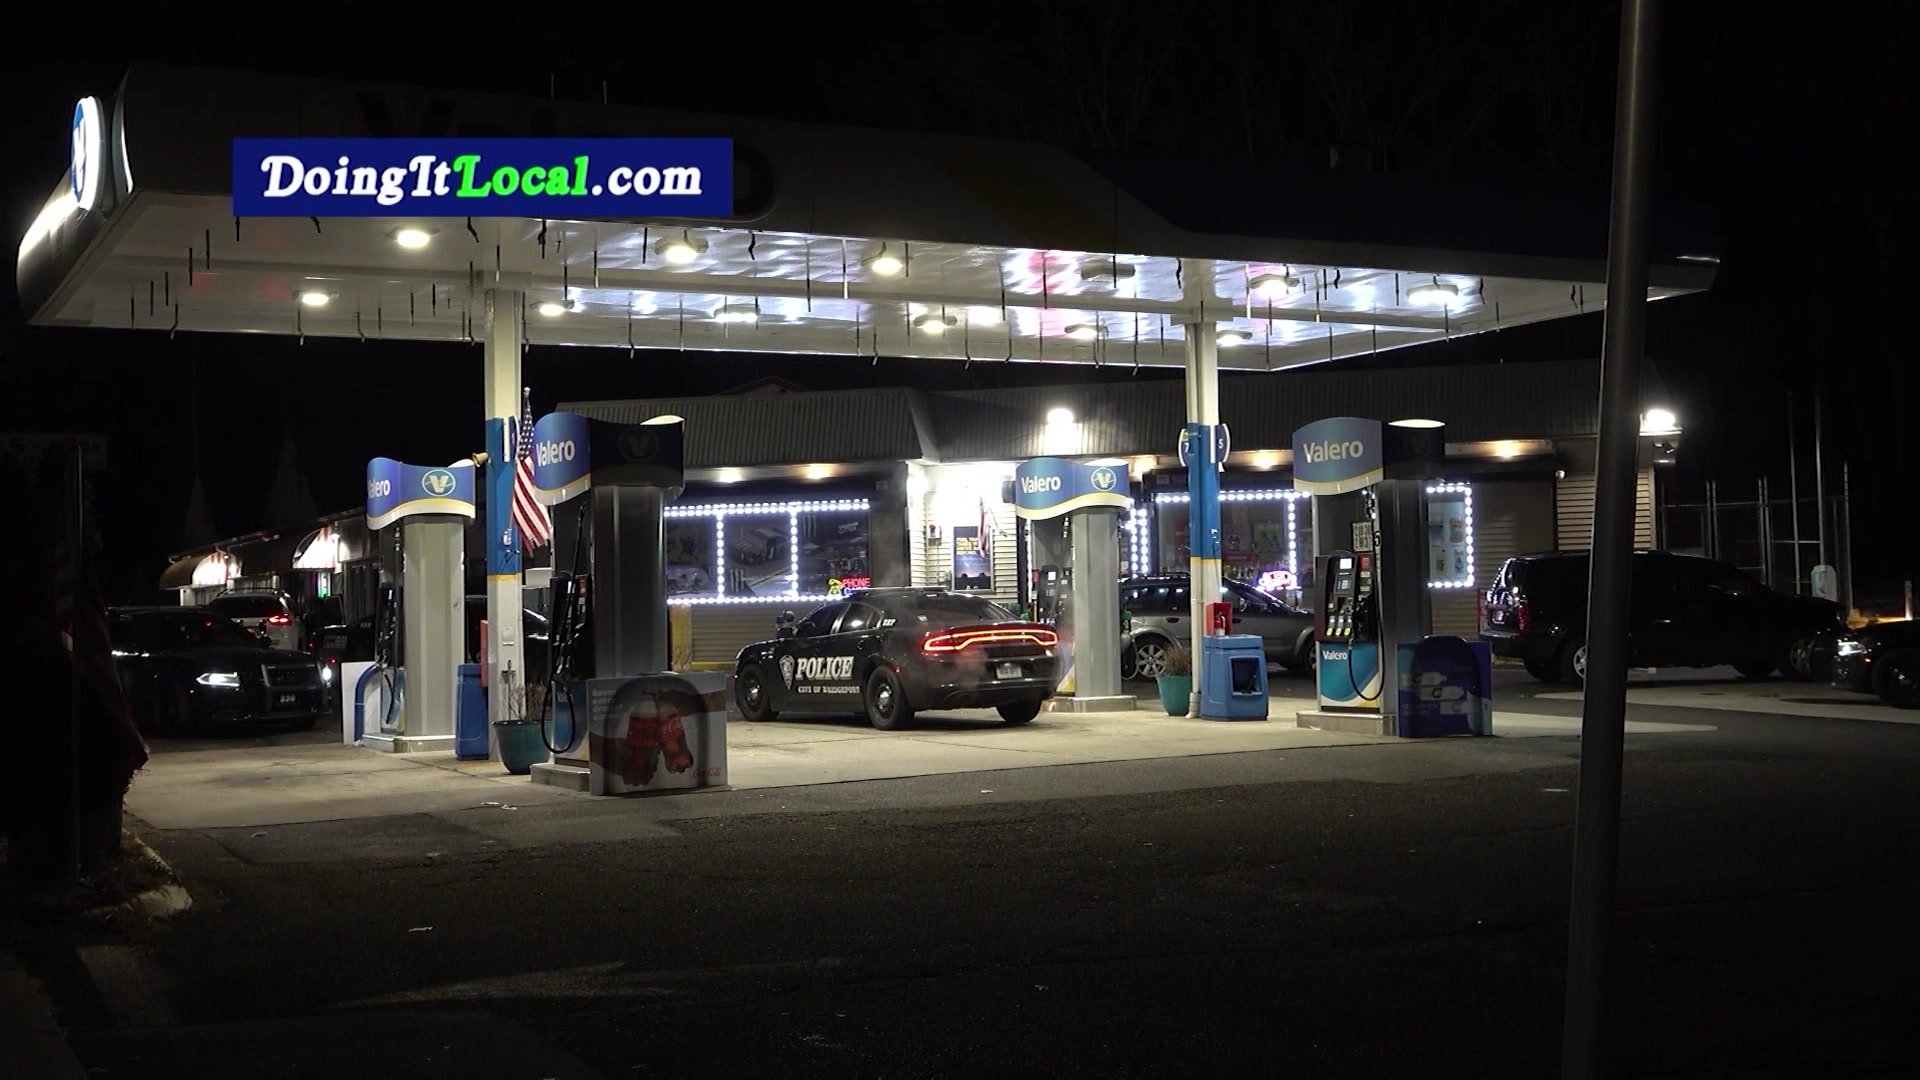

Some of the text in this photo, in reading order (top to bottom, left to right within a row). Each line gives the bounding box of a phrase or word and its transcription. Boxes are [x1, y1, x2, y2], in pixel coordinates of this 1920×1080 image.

[1218, 438, 1224, 449] 5
[1303, 440, 1364, 464] Valero
[535, 440, 576, 468] Valero
[1021, 475, 1062, 494] Valero
[842, 578, 869, 587] PHONE
[1322, 650, 1348, 660] Valero
[795, 656, 855, 680] POLICE
